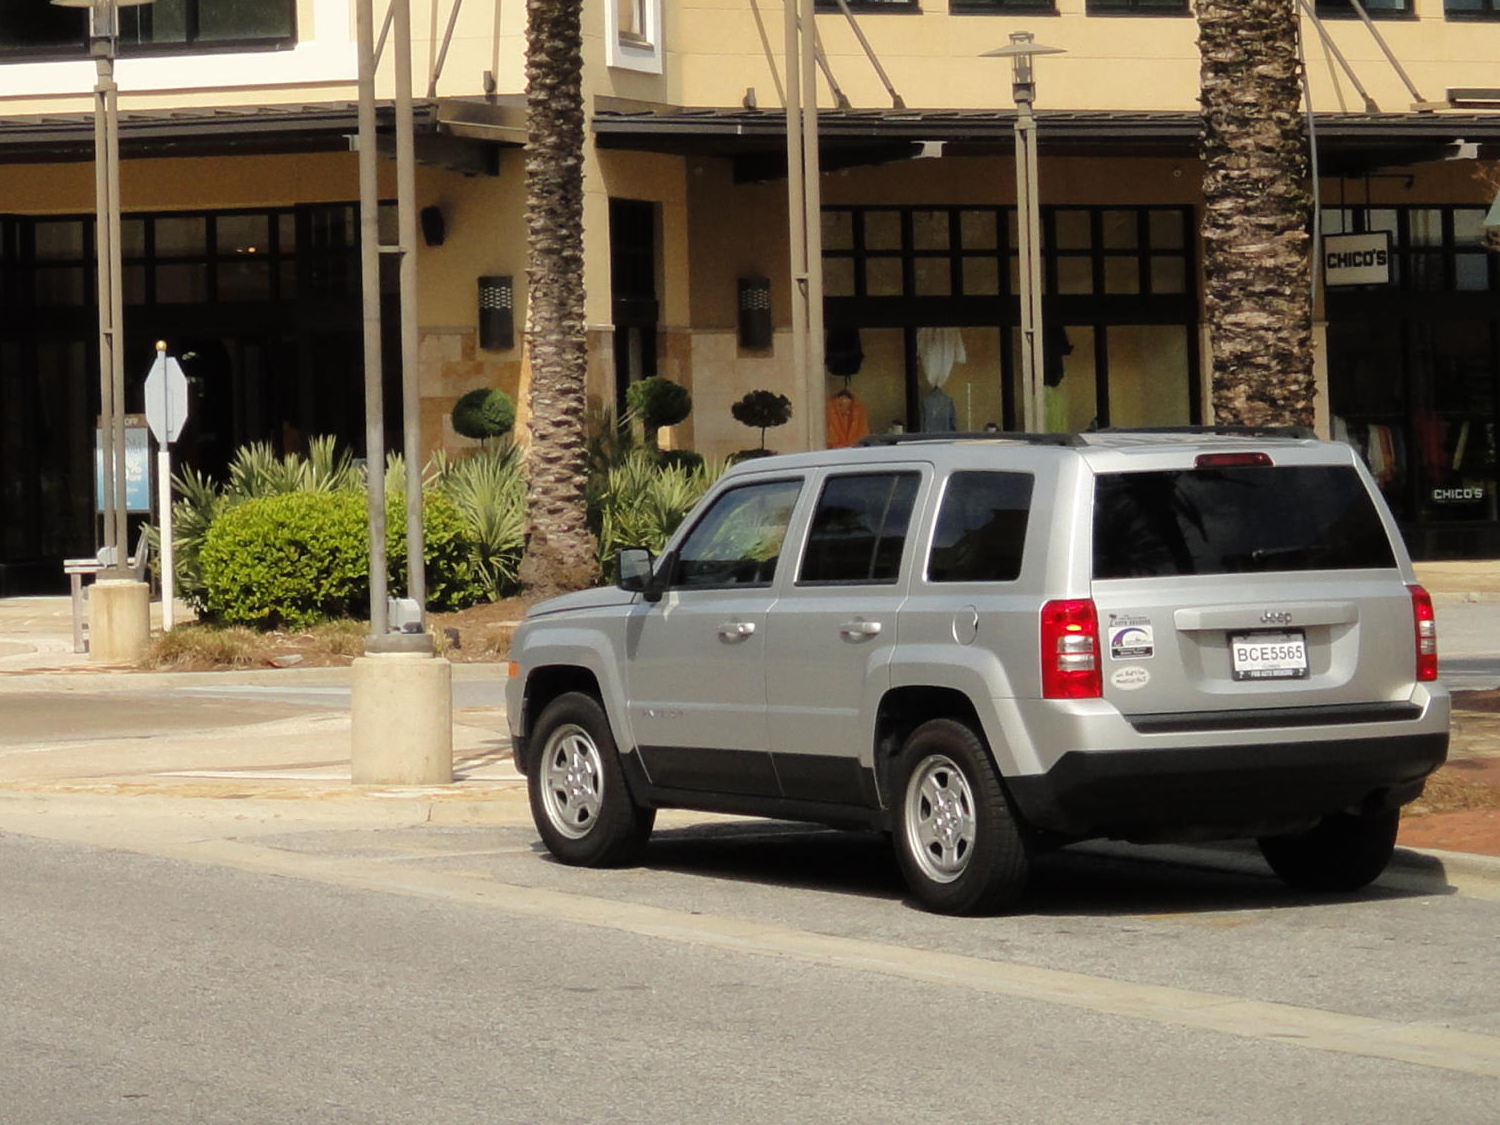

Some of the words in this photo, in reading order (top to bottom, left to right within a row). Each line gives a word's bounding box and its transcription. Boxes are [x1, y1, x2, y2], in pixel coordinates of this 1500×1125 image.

[1326, 247, 1387, 269] CHICO'S
[1434, 487, 1484, 500] CHICO'S
[1260, 610, 1293, 627] Jeep
[1237, 645, 1304, 663] BCE5565
